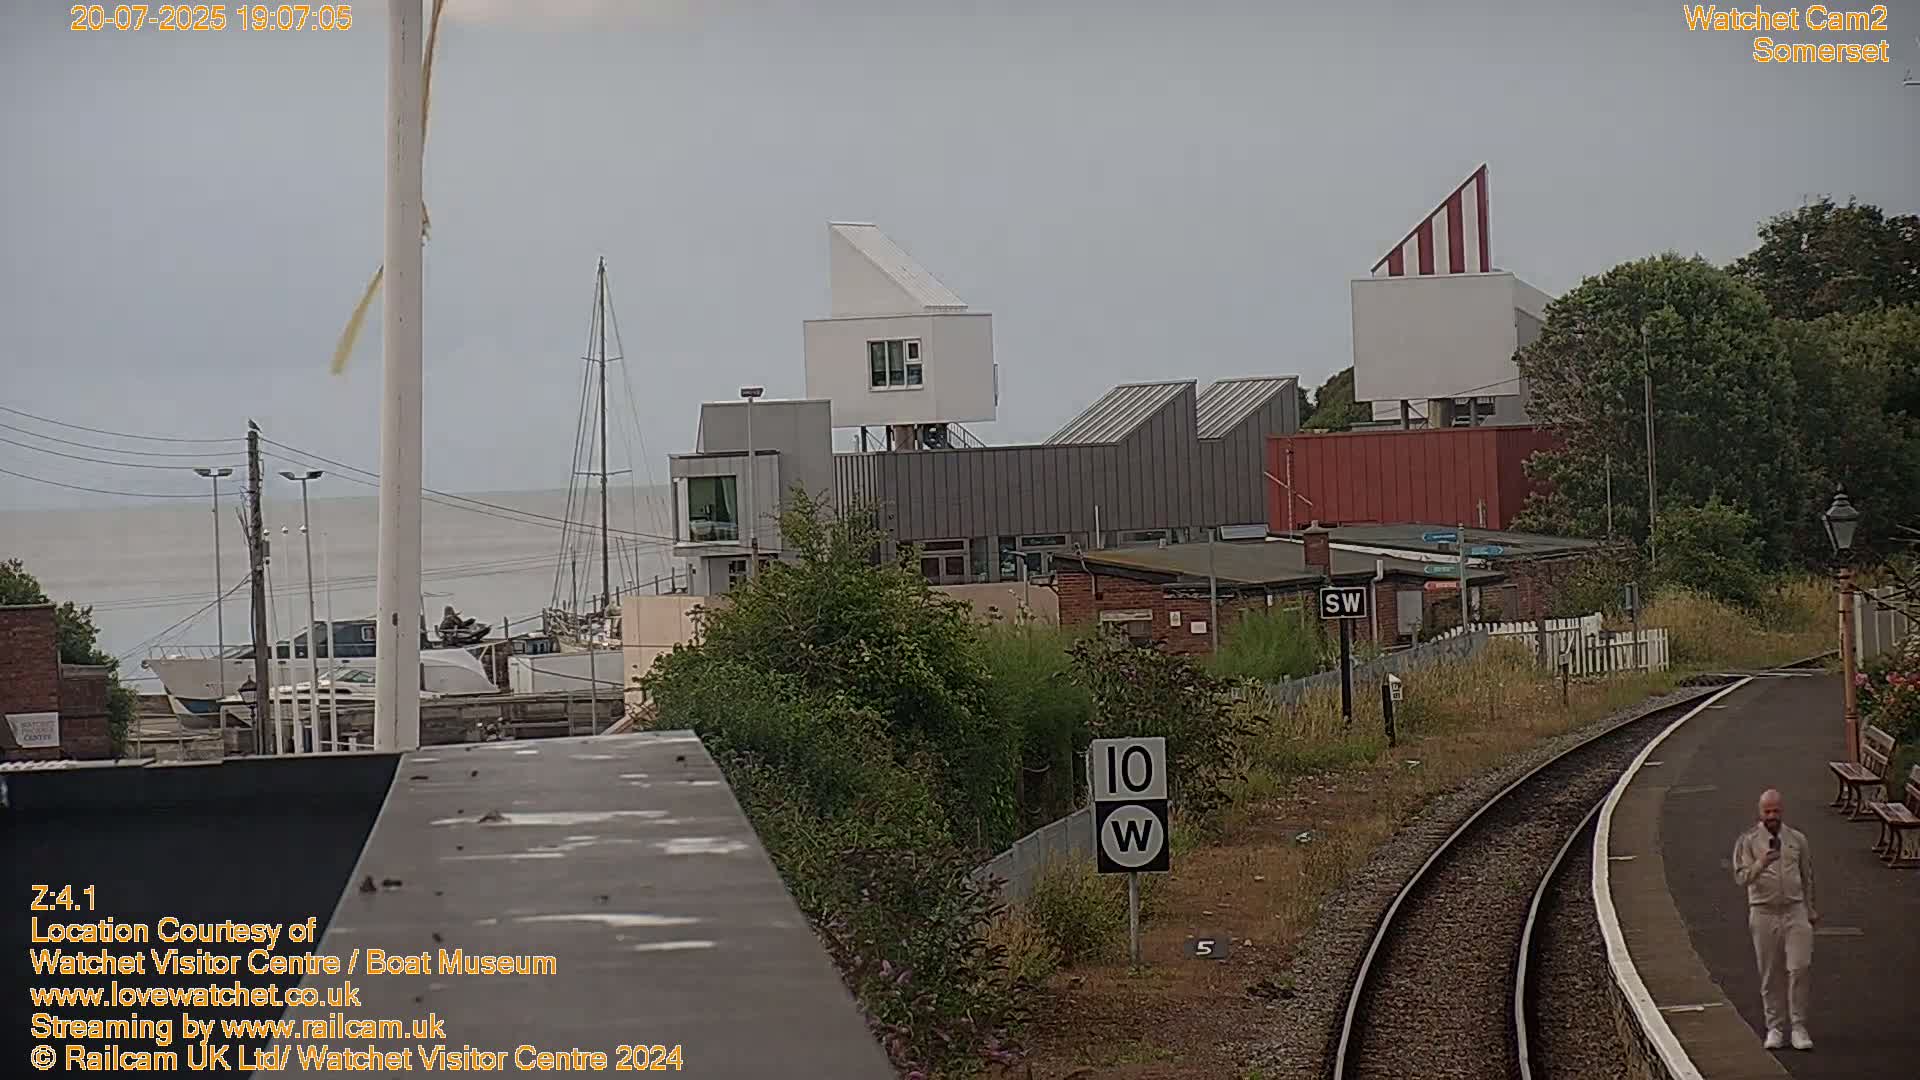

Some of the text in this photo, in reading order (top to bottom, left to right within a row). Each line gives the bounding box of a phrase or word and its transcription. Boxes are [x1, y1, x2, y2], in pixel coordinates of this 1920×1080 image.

[1325, 592, 1361, 613] SW
[1107, 745, 1153, 793] 10
[1111, 819, 1153, 853] W
[1195, 940, 1216, 956] 5
